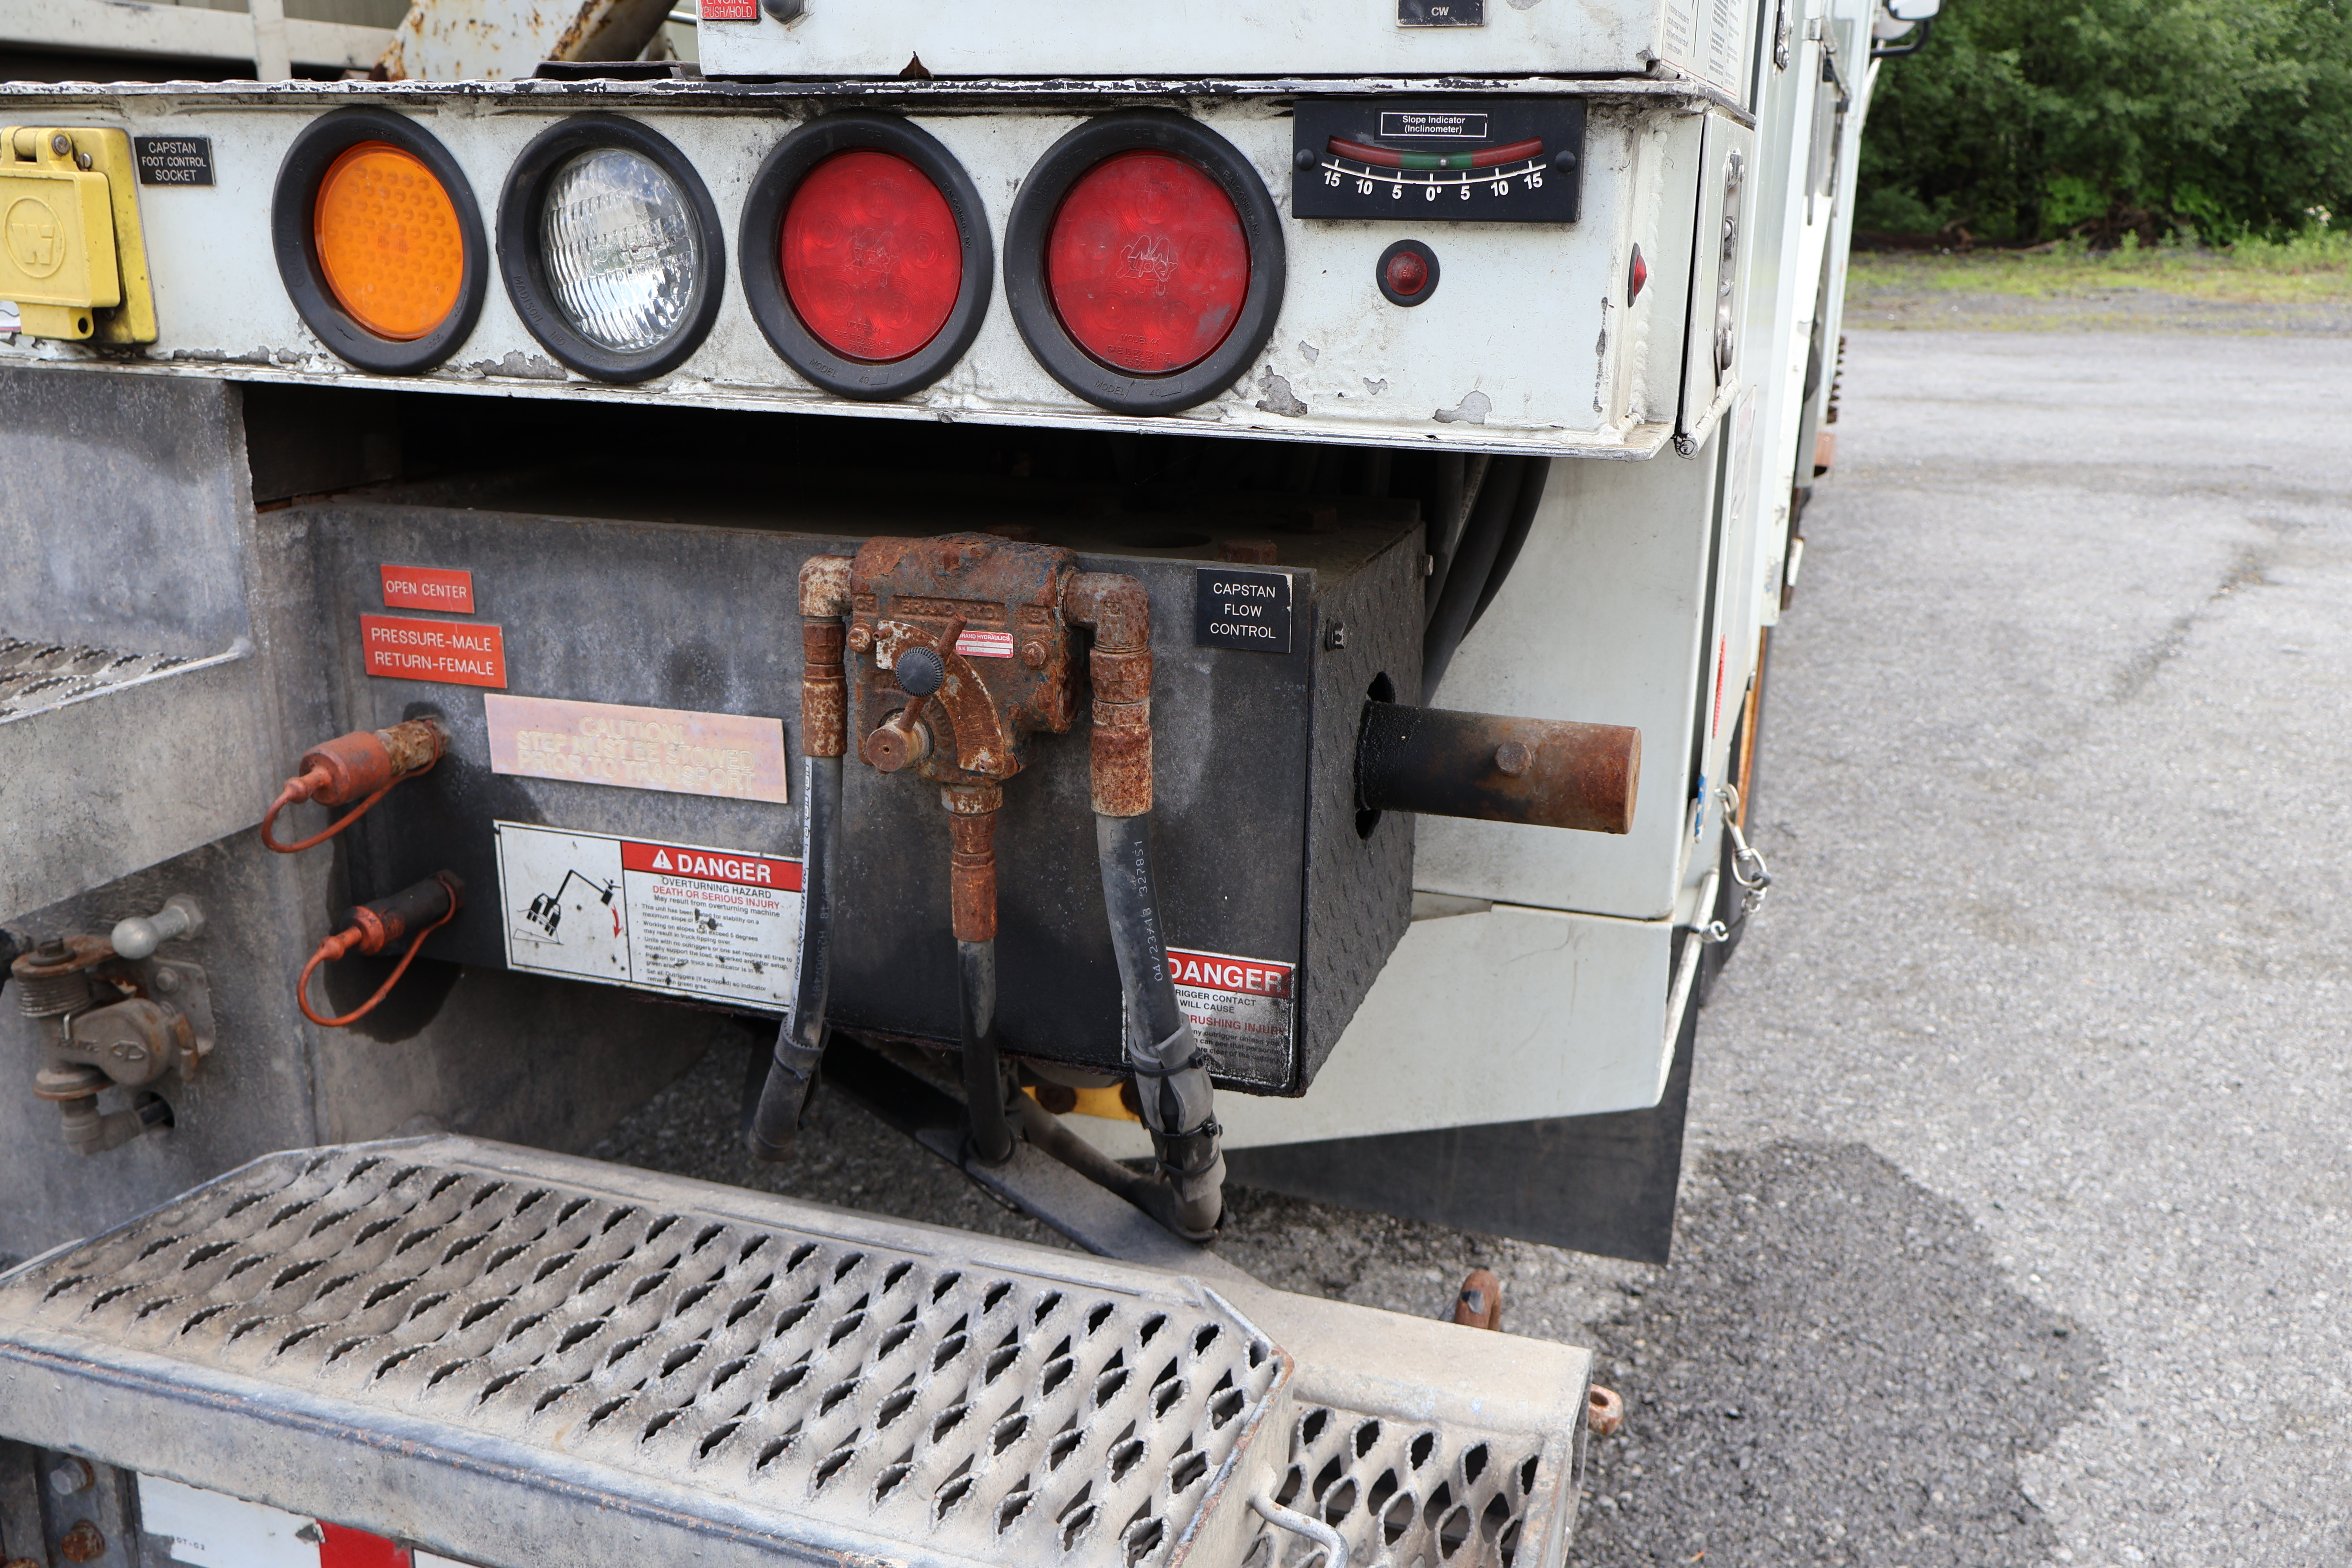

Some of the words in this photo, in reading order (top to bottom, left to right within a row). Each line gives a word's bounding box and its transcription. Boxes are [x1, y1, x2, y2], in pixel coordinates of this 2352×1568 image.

[704, 5, 753, 18] PUSH/HOLD
[1431, 7, 1449, 16] CW
[1403, 115, 1426, 125] Slope
[1428, 116, 1465, 124] Indicator
[1124, 128, 1151, 139] TOP
[1405, 124, 1462, 134] (Inclinometer)
[148, 142, 196, 154] CAPSTAN
[142, 156, 164, 167] FOOT
[167, 157, 207, 167] CONTROL
[155, 169, 196, 181] SOCKET
[1324, 170, 1341, 187] 15
[1356, 179, 1373, 195] 10
[1392, 184, 1402, 199] 5
[1460, 185, 1470, 200] 5
[1490, 180, 1509, 196] 10
[1524, 172, 1543, 189] 15
[1252, 222, 1260, 236] NY
[1120, 333, 1149, 345] MODEL
[1107, 344, 1123, 354] SAE
[1134, 358, 1152, 368] DOT
[809, 358, 837, 378] MODEL
[858, 376, 870, 384] 40
[1094, 380, 1125, 396] MODEL
[386, 580, 417, 594] OPEN
[421, 583, 467, 599] CENTER
[1213, 583, 1275, 598] CAPSTAN
[1225, 603, 1262, 617] FLOW
[1210, 622, 1276, 639] CONTROL
[370, 627, 493, 652] PRESSURE-MALE
[374, 651, 495, 676] RETURN-FEMALE
[579, 716, 684, 745] CAUTION!
[517, 730, 567, 752] STEP
[572, 735, 628, 759] MUST
[633, 740, 661, 762] BE
[666, 743, 755, 771] STOWED
[517, 749, 585, 775] PRIOR
[587, 755, 618, 778] TO
[621, 759, 756, 791] TRANSPORT
[677, 854, 771, 884] DANGER
[1133, 840, 1148, 896] 327851
[662, 877, 730, 893] OVERTURNING
[732, 886, 771, 899] HAZARD
[653, 885, 684, 897] DEATH
[686, 888, 699, 899] OR
[702, 892, 744, 905] SERIOUS
[746, 897, 780, 909] INJURY
[654, 894, 667, 904] May
[670, 896, 689, 905] result
[691, 899, 707, 907] from
[708, 902, 749, 915] overturning
[750, 908, 780, 917] machine
[643, 920, 666, 929] Working
[723, 915, 746, 924] stability
[682, 942, 711, 951] outriggers
[697, 935, 717, 944] tipping
[715, 962, 740, 971] indicator
[665, 971, 695, 980] Outriggers
[741, 982, 766, 991] indicator
[1168, 957, 1283, 993] DANGER
[1180, 999, 1201, 1009] WILL
[1203, 1002, 1235, 1014] CAUSE
[1212, 994, 1256, 1006] CONTACT
[1245, 1022, 1286, 1036] INJURY
[1204, 1030, 1238, 1041] outrigger
[1240, 1035, 1264, 1045] unless
[1209, 1047, 1228, 1055] clear
[1238, 1050, 1250, 1058] the
[1230, 1042, 1244, 1050] that
